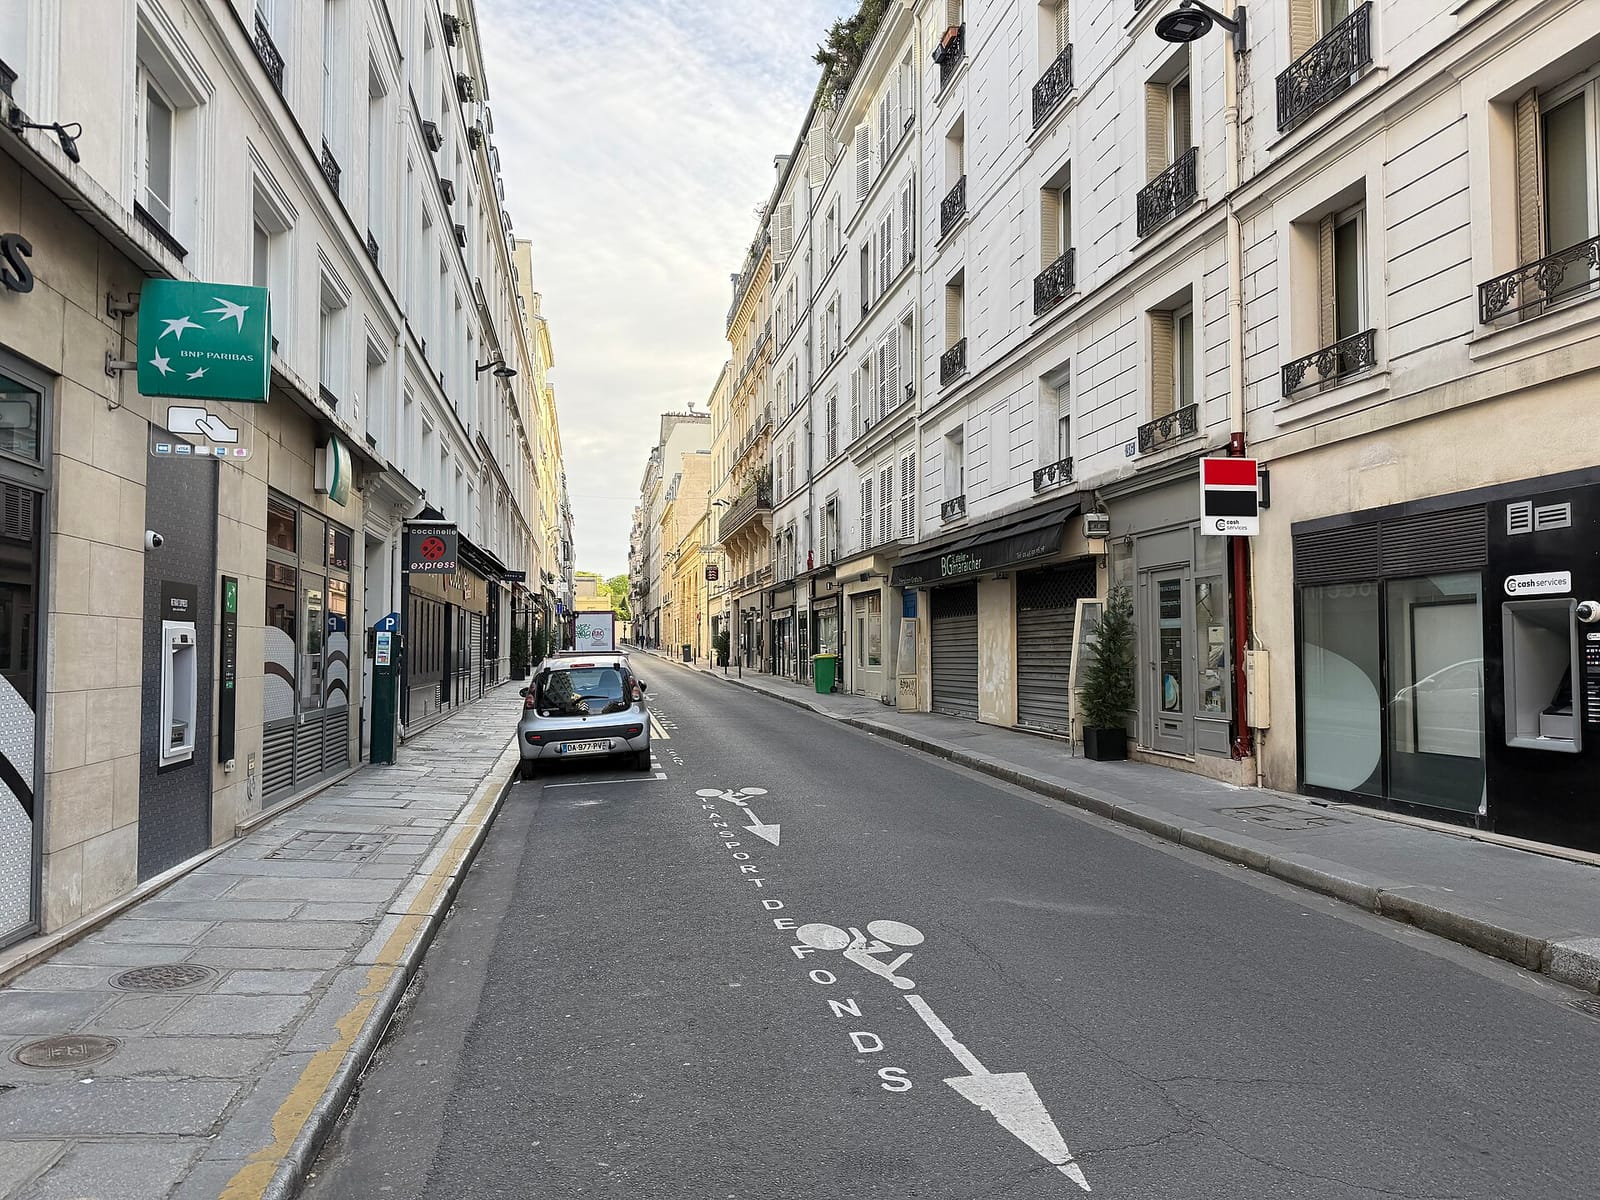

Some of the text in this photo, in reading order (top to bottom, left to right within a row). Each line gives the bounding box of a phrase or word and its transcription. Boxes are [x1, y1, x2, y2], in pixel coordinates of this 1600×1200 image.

[180, 350, 254, 361] BNP PARIBAS
[411, 527, 457, 536] coccinelle
[410, 561, 455, 571] express
[941, 554, 953, 577] BG
[1517, 578, 1567, 588] cash services
[385, 617, 395, 630] P
